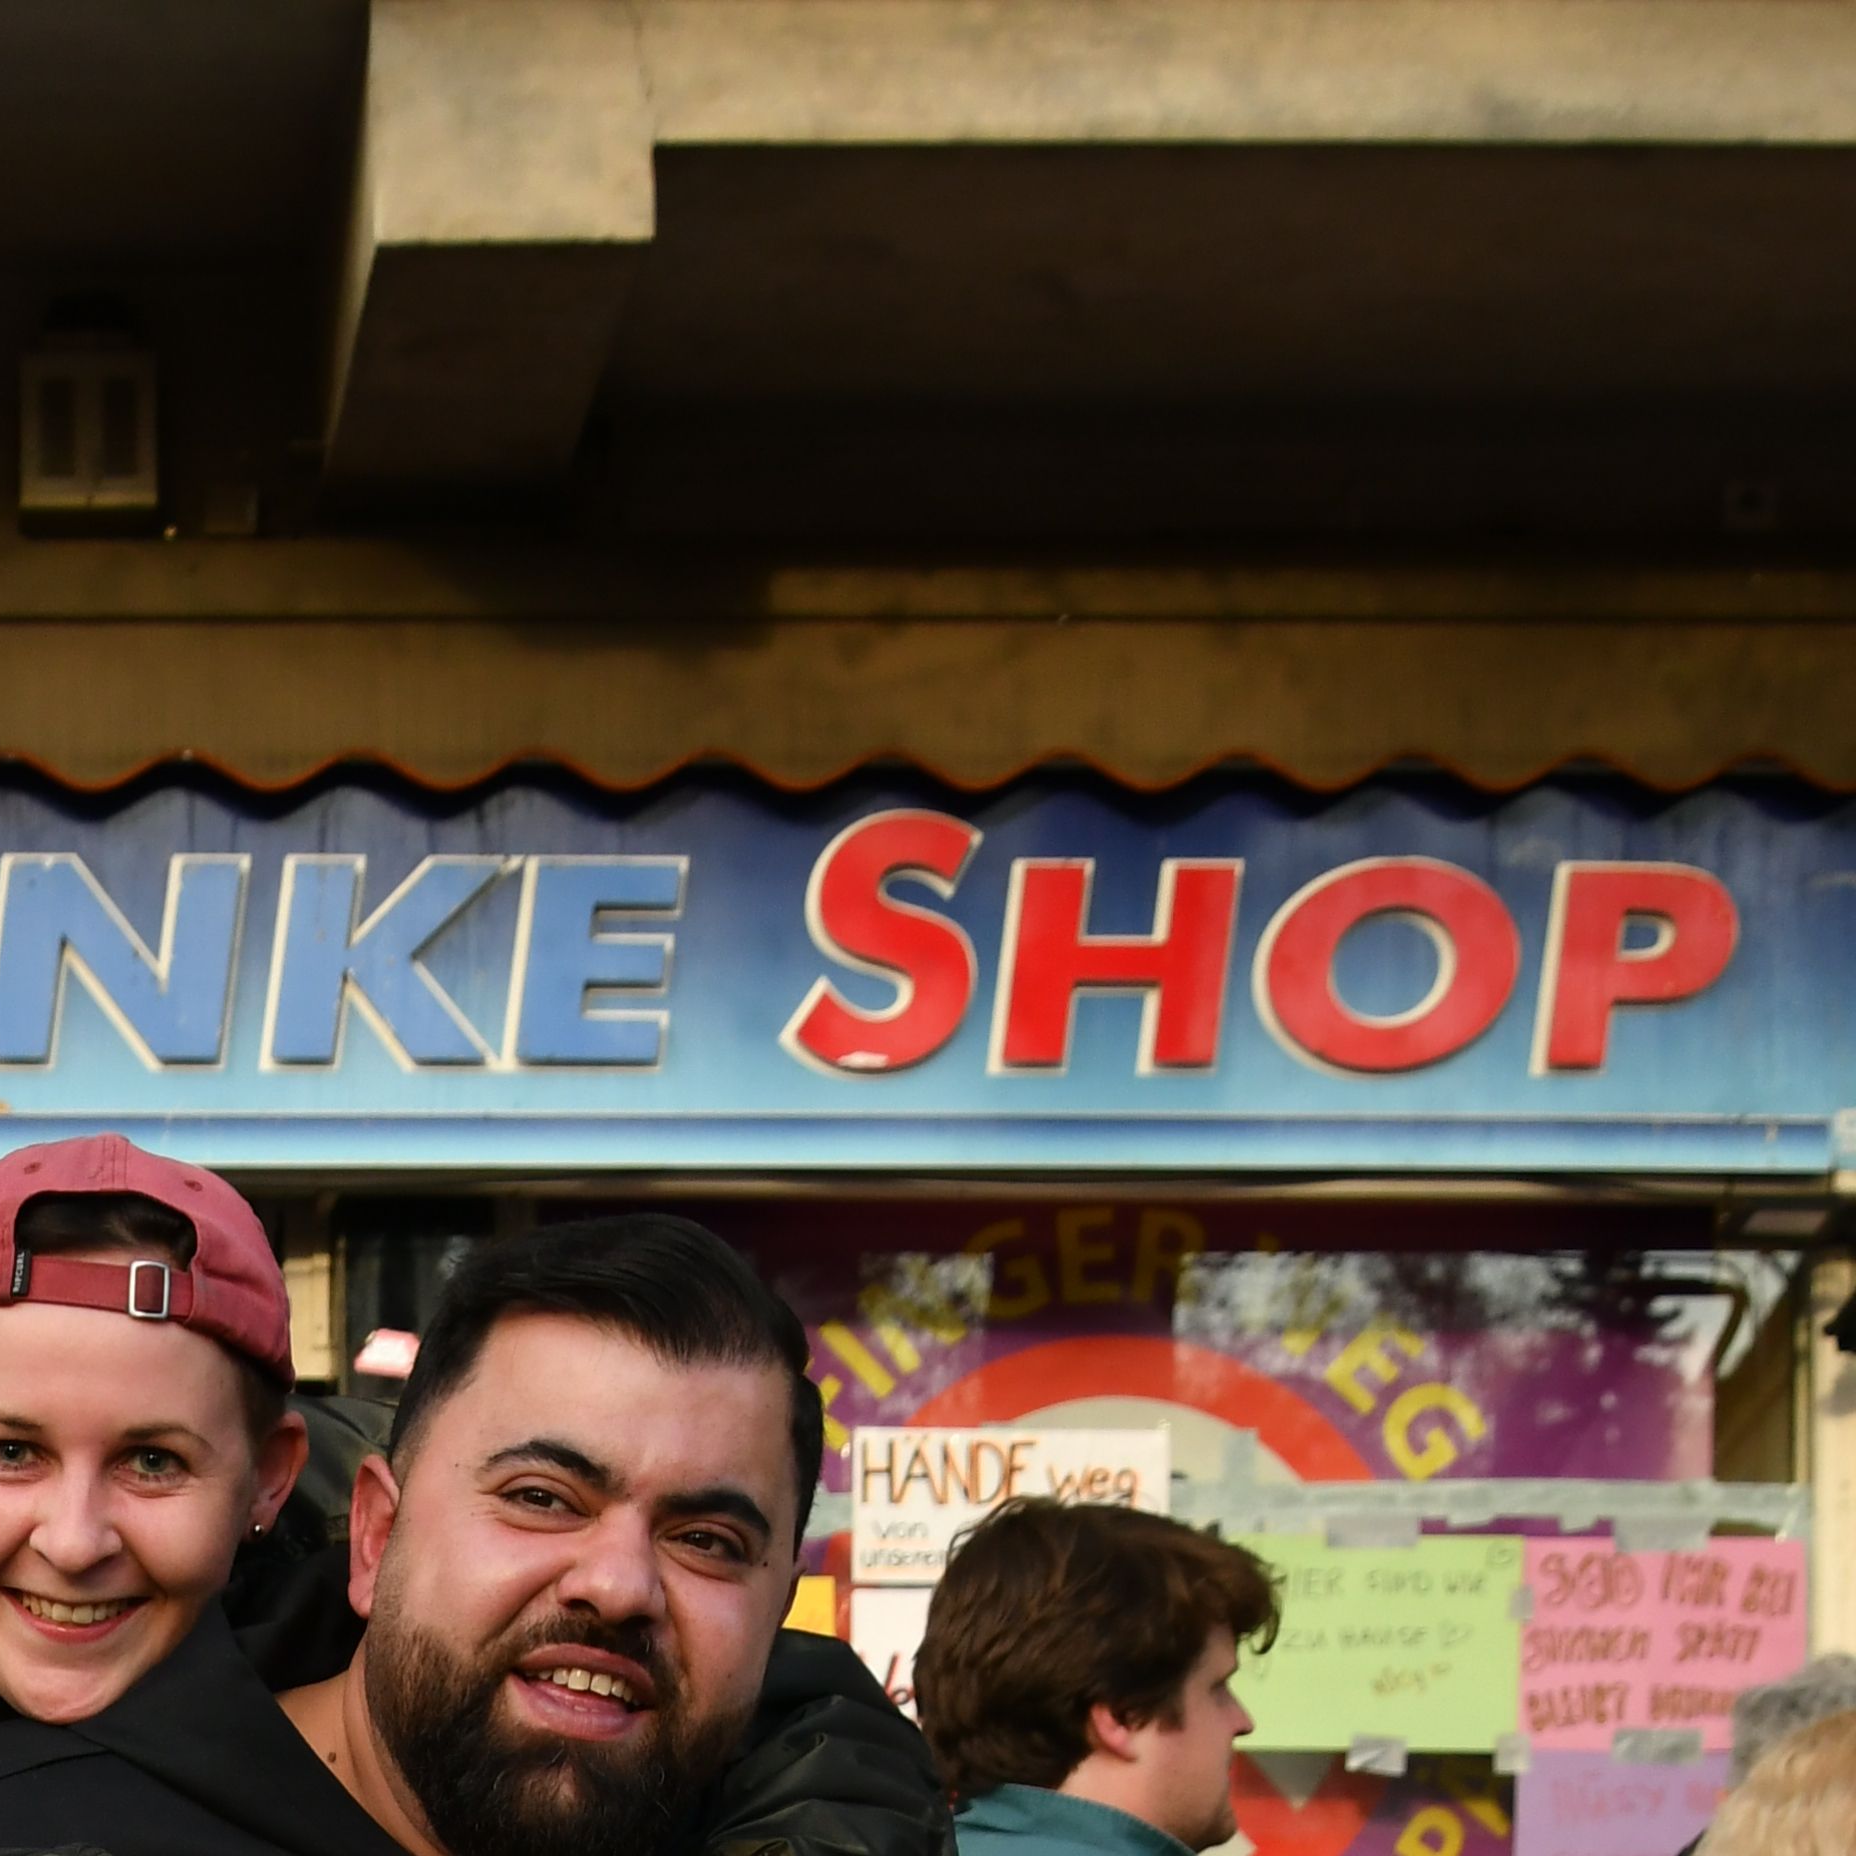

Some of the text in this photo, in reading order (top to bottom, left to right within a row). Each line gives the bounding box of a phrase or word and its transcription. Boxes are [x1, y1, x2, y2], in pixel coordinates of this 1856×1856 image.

[779, 808, 1741, 1077] SHOP
[1047, 1463, 1139, 1509] weg
[1290, 1565, 1346, 1599] IER
